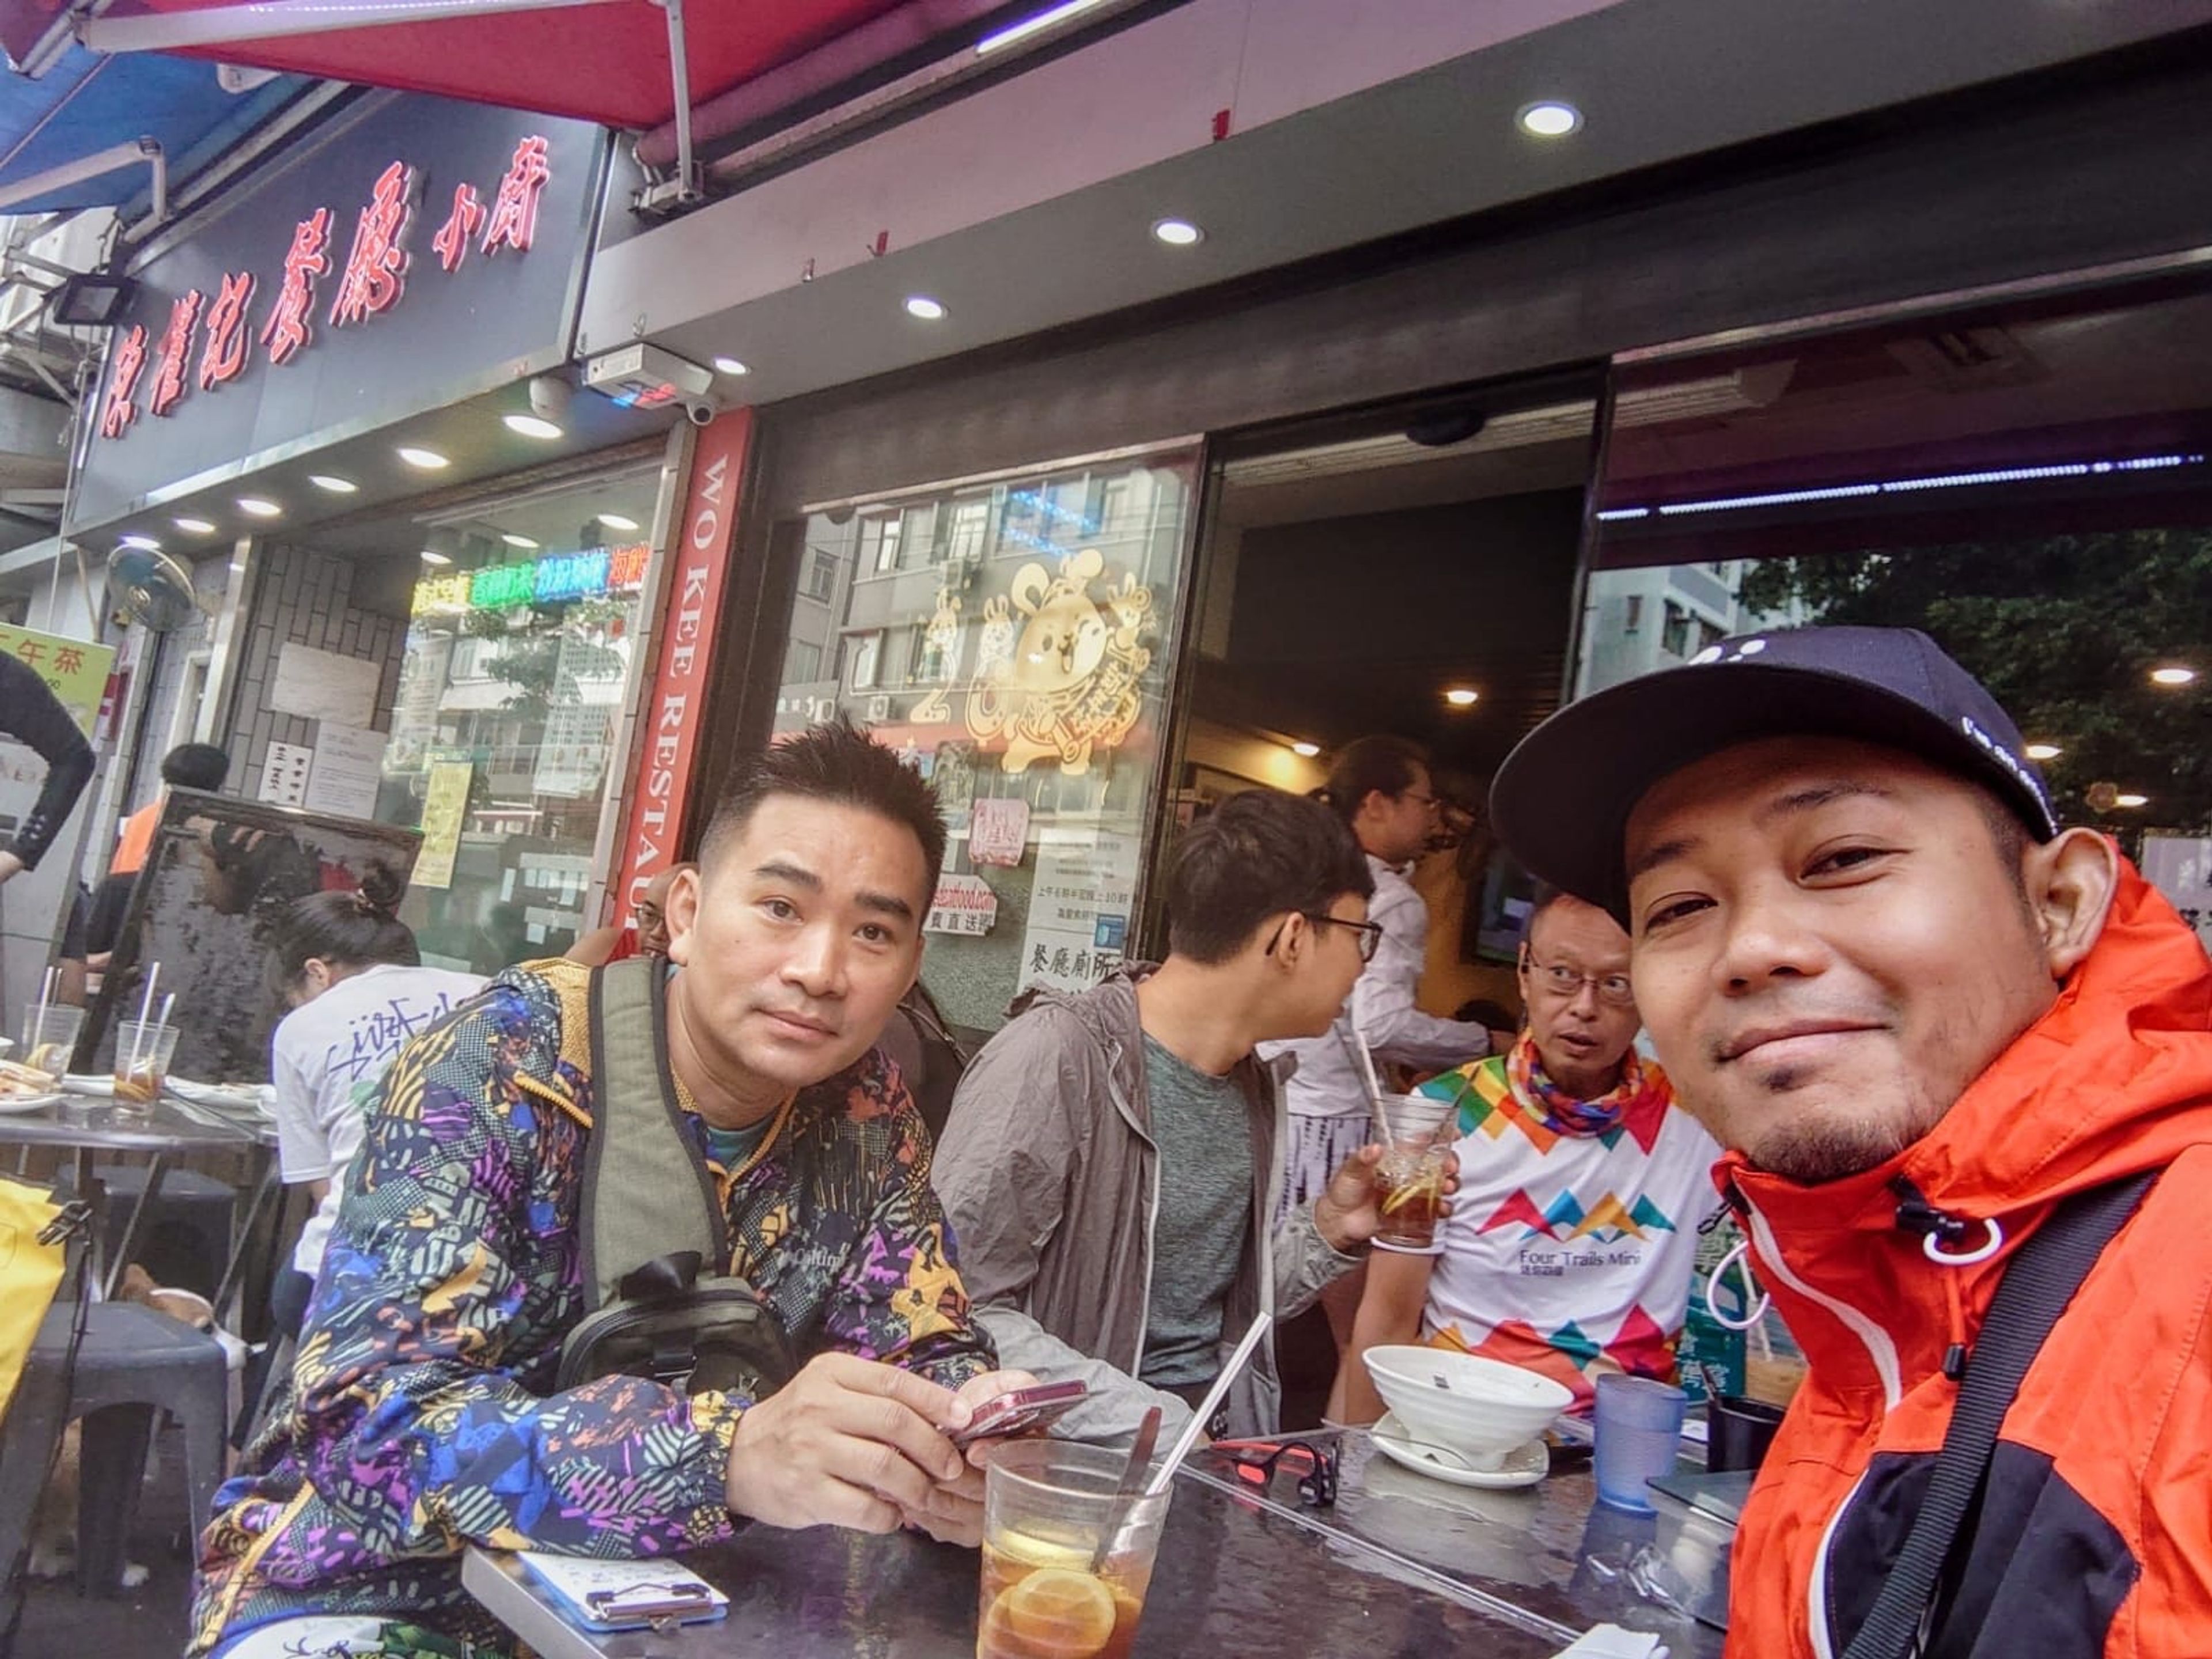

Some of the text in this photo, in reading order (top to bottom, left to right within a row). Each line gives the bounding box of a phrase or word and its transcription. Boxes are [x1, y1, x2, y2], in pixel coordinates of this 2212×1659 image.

[624, 453, 728, 929] WO KEE RESTAU
[1519, 1249, 1641, 1266] Four Trails Mini
